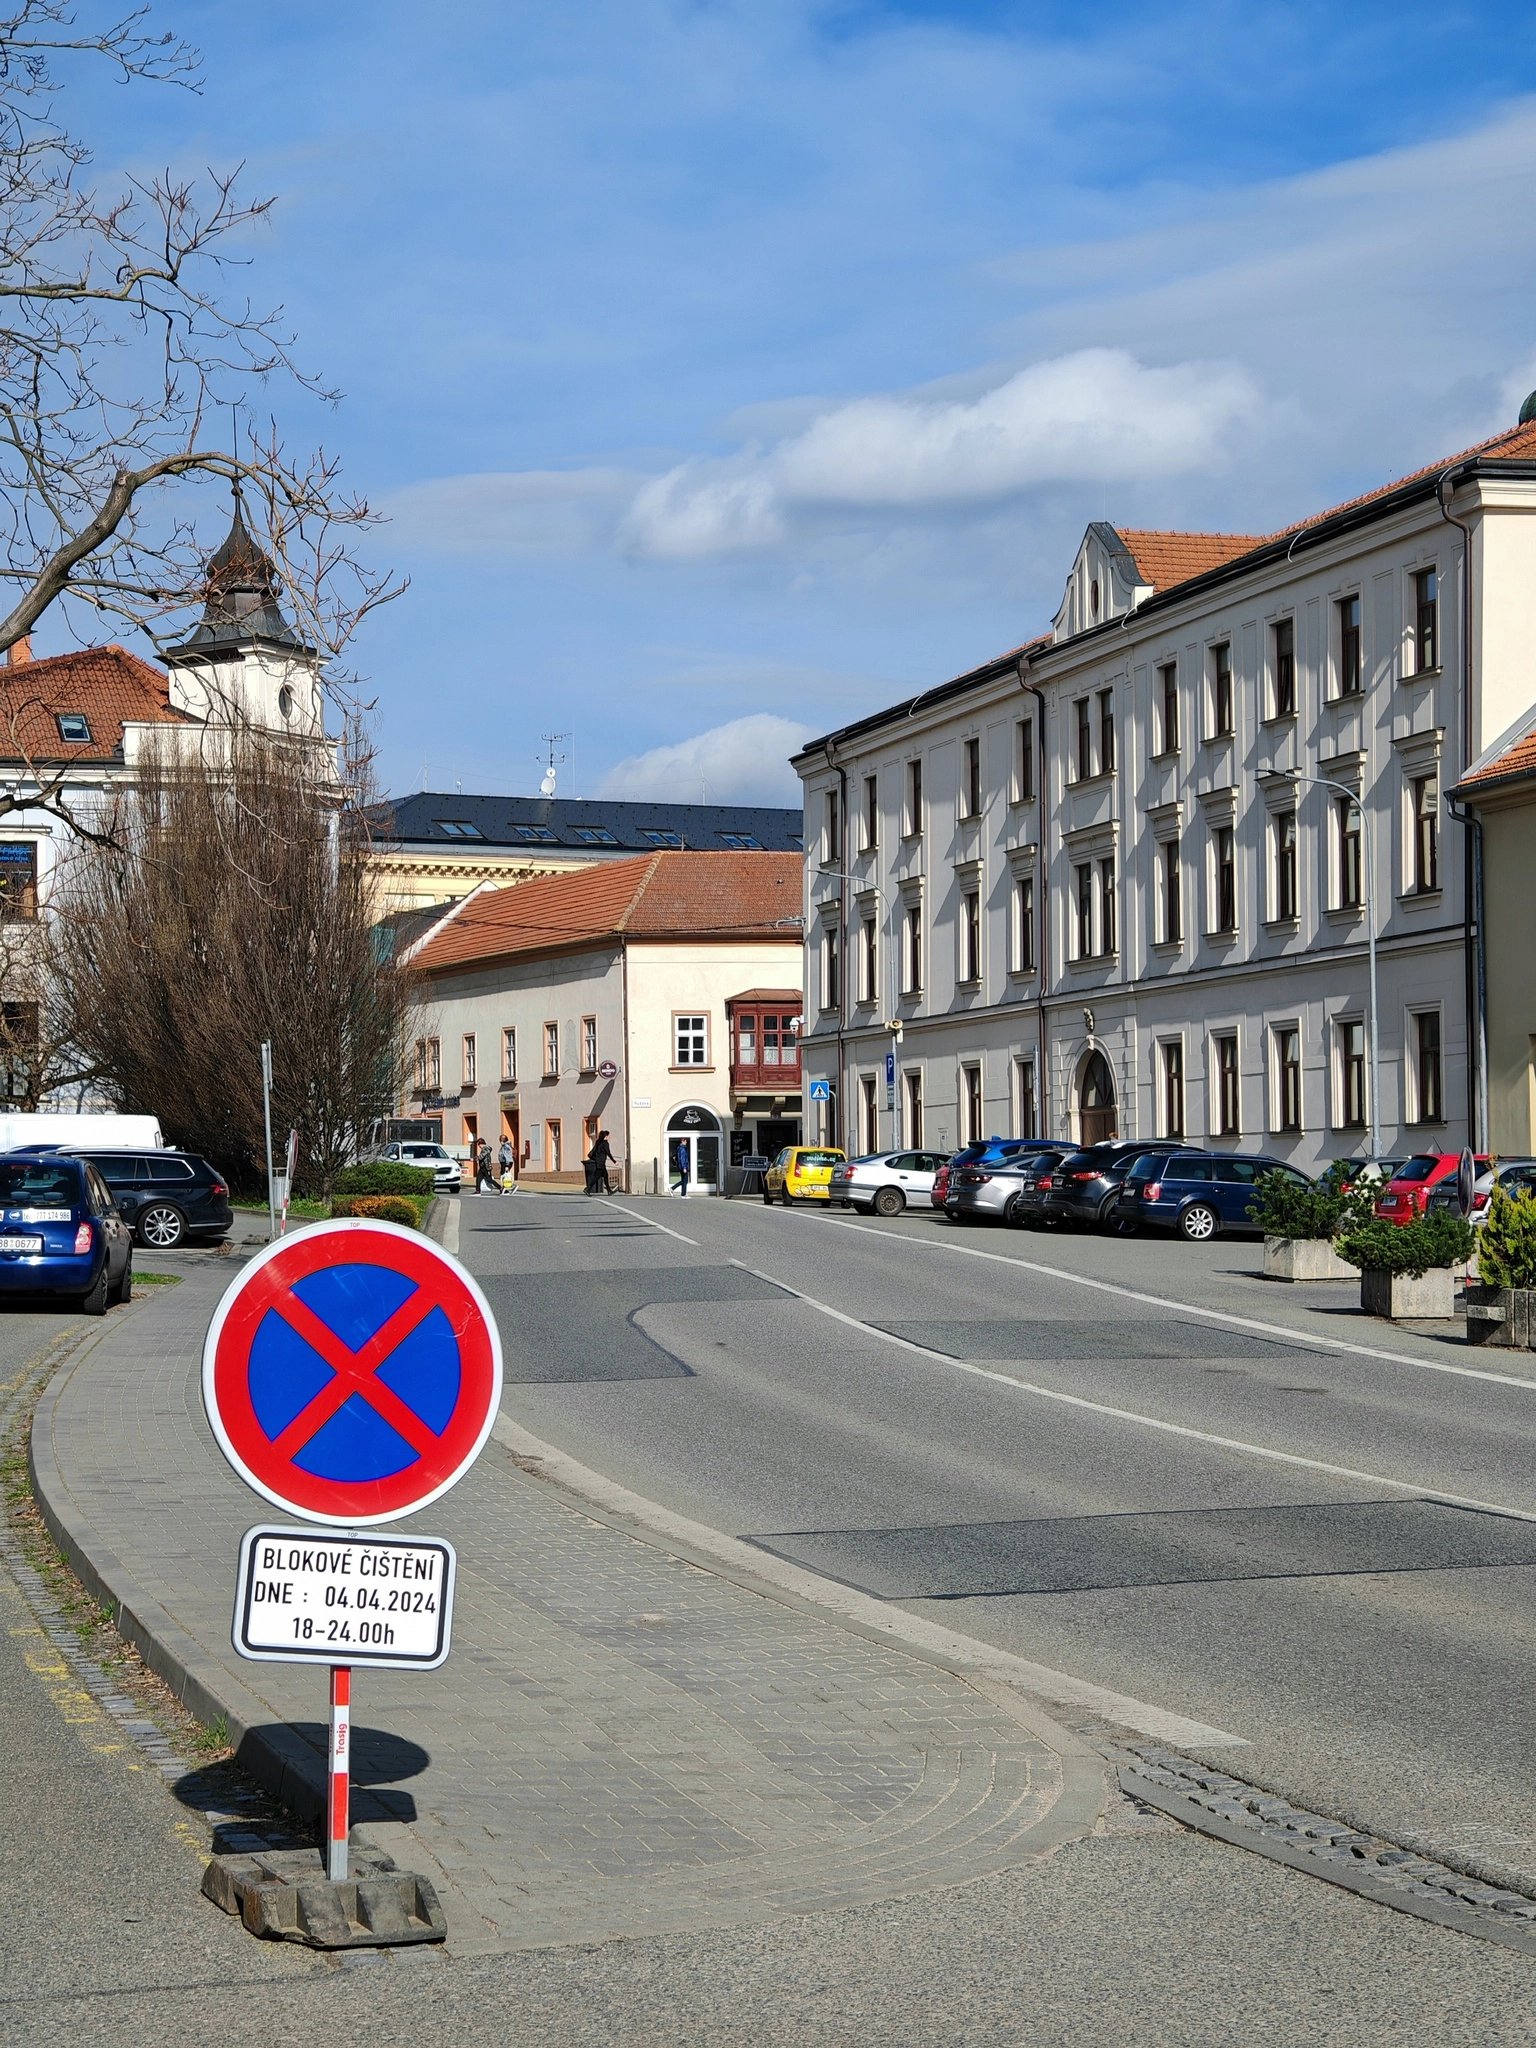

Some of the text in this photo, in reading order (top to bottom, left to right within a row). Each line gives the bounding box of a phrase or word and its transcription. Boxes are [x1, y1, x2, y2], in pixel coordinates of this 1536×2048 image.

[15, 1240, 37, 1248] 0677
[263, 1548, 436, 1581] BLOKOVÉ ČIŠTĚNÍ
[254, 1581, 294, 1604] DNE
[325, 1586, 436, 1614] 04.04.2024
[292, 1617, 394, 1645] 18-24.00h
[336, 1723, 348, 1756] Trasig
